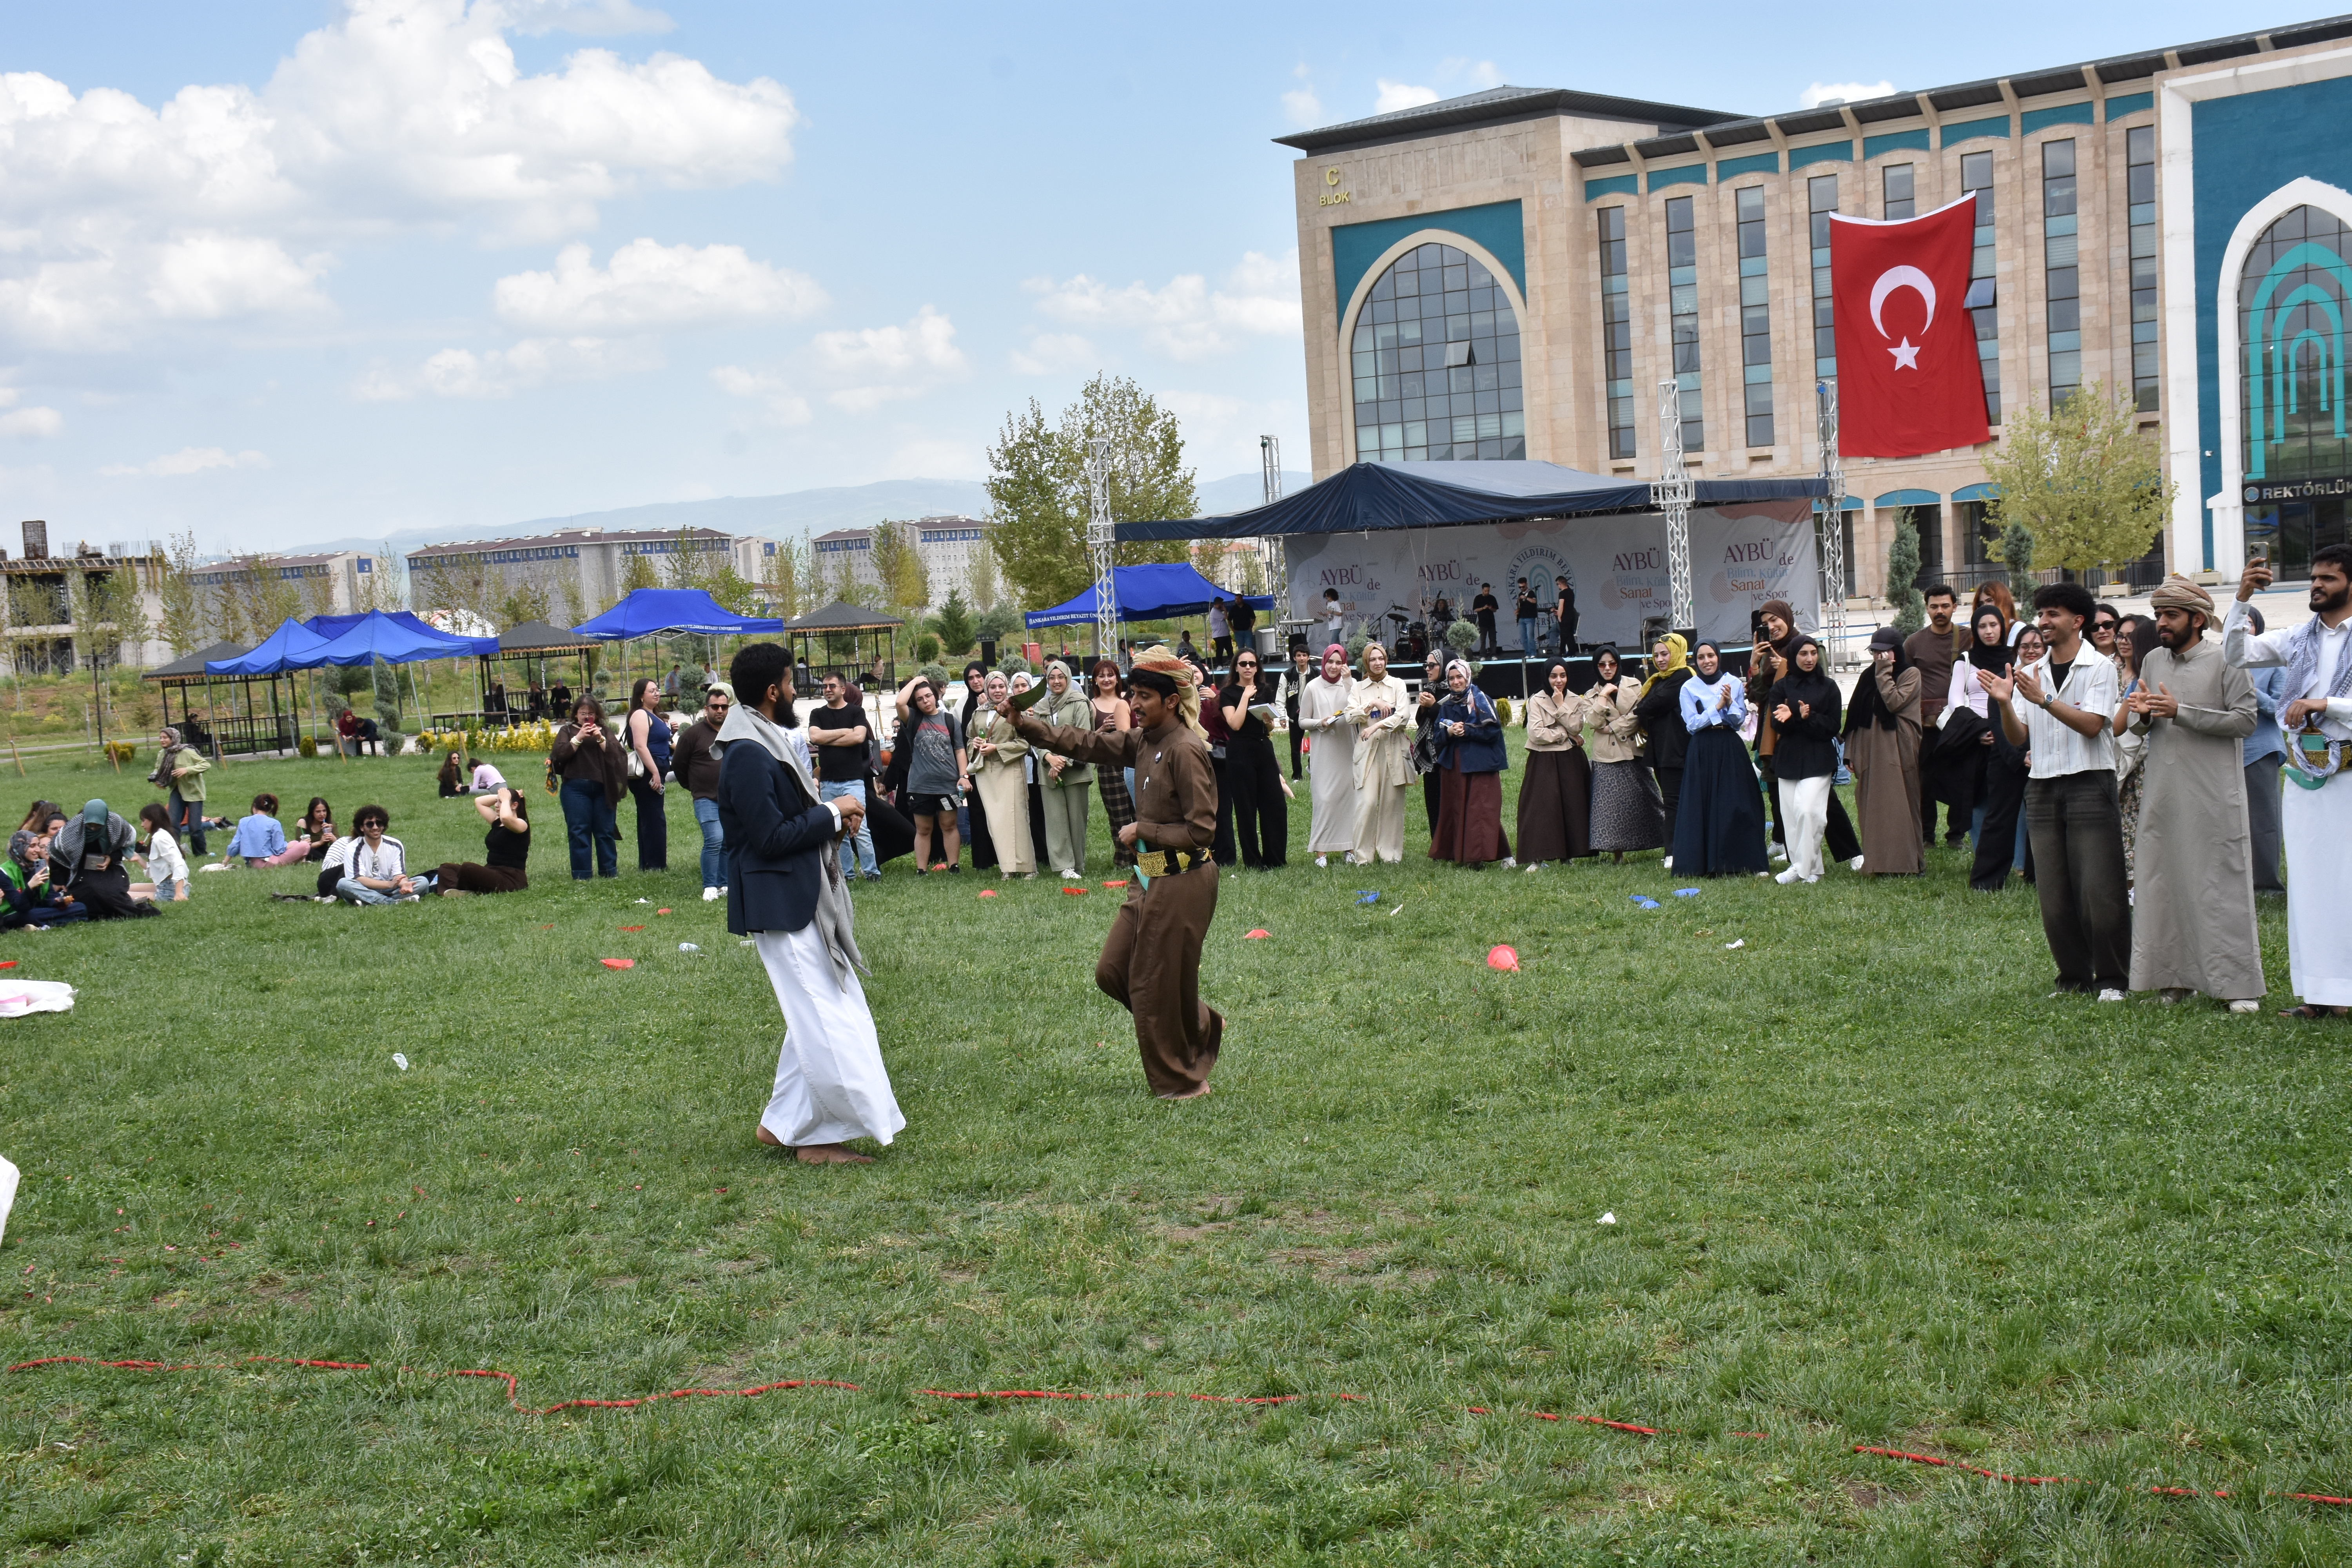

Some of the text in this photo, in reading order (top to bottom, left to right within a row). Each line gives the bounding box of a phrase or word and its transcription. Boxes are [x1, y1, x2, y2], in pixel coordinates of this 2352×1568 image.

[1326, 167, 1338, 185] C
[1319, 191, 1349, 206] BLOK
[2263, 479, 2352, 499] REKTÖRLÜK
[1612, 547, 1661, 571] AYBÜ
[1724, 538, 1794, 566] AYBÜ de
[1417, 559, 1480, 586] AYBÜ de
[1516, 548, 1556, 564] YILDIRIM
[1557, 559, 1574, 590] BEYAZ
[1727, 567, 1789, 579] Bilim, Kültür
[1319, 564, 1381, 590] AYBÜ de
[1616, 575, 1671, 587] Bilim, Kültü
[1620, 587, 1652, 599] Sanat
[1731, 579, 1765, 592] Sanat
[1350, 591, 1377, 601] Kültür
[1766, 590, 1789, 600] Spor
[1357, 612, 1376, 622] Spor
